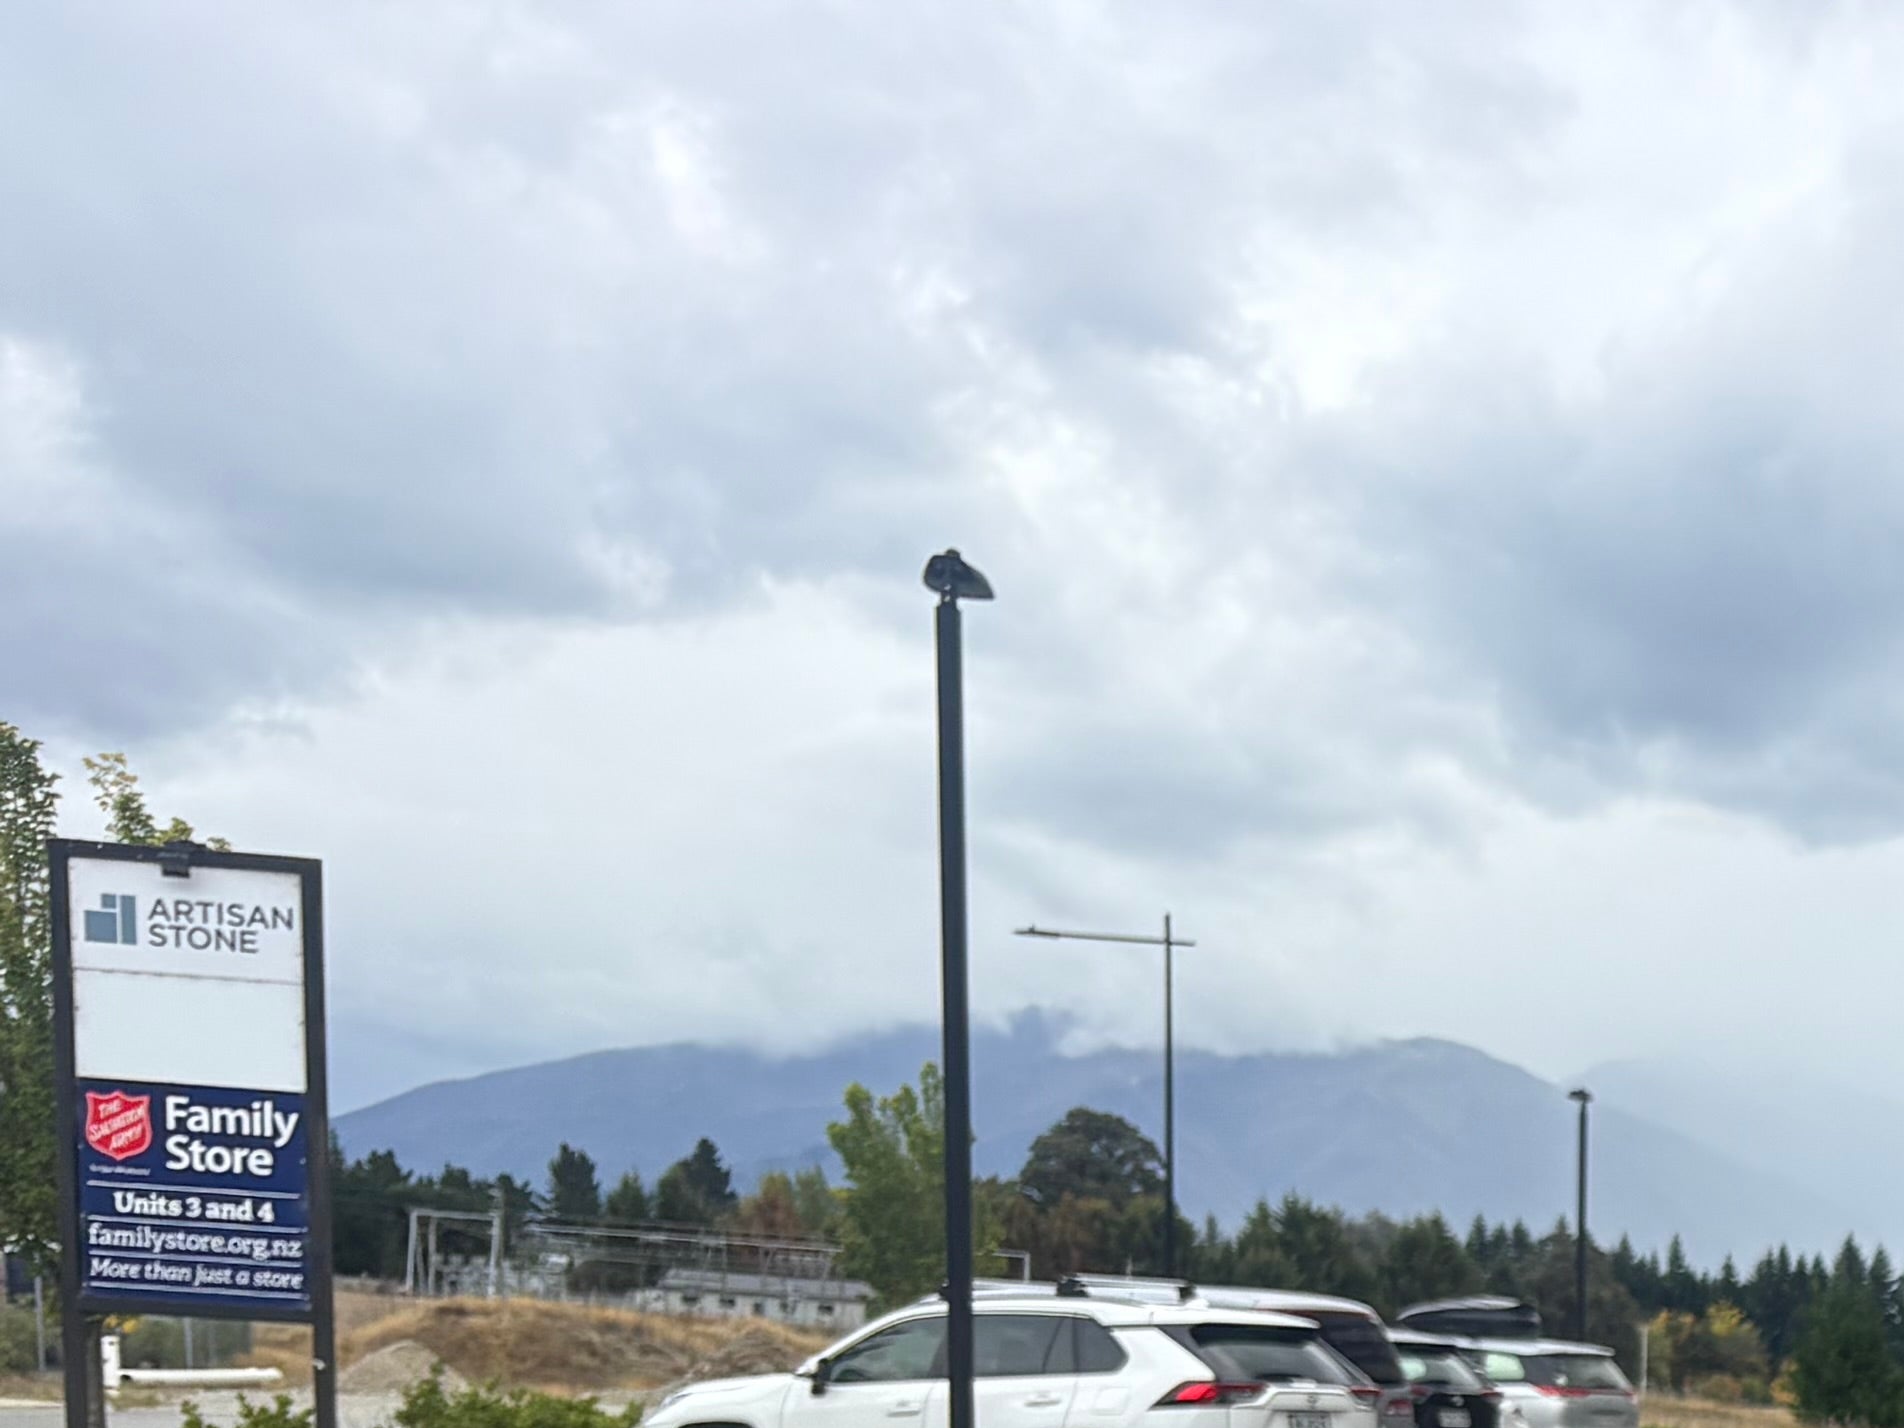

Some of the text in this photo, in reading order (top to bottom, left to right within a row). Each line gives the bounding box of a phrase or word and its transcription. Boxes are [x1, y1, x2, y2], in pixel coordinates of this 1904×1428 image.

[148, 898, 293, 931] ARTISAN
[148, 923, 259, 954] STONE
[165, 1095, 299, 1148] Family
[165, 1134, 274, 1176] Store
[112, 1190, 275, 1223] Units 3 and 4
[88, 1222, 304, 1261] familystore.org.nz
[90, 1257, 304, 1290] More than just a store
